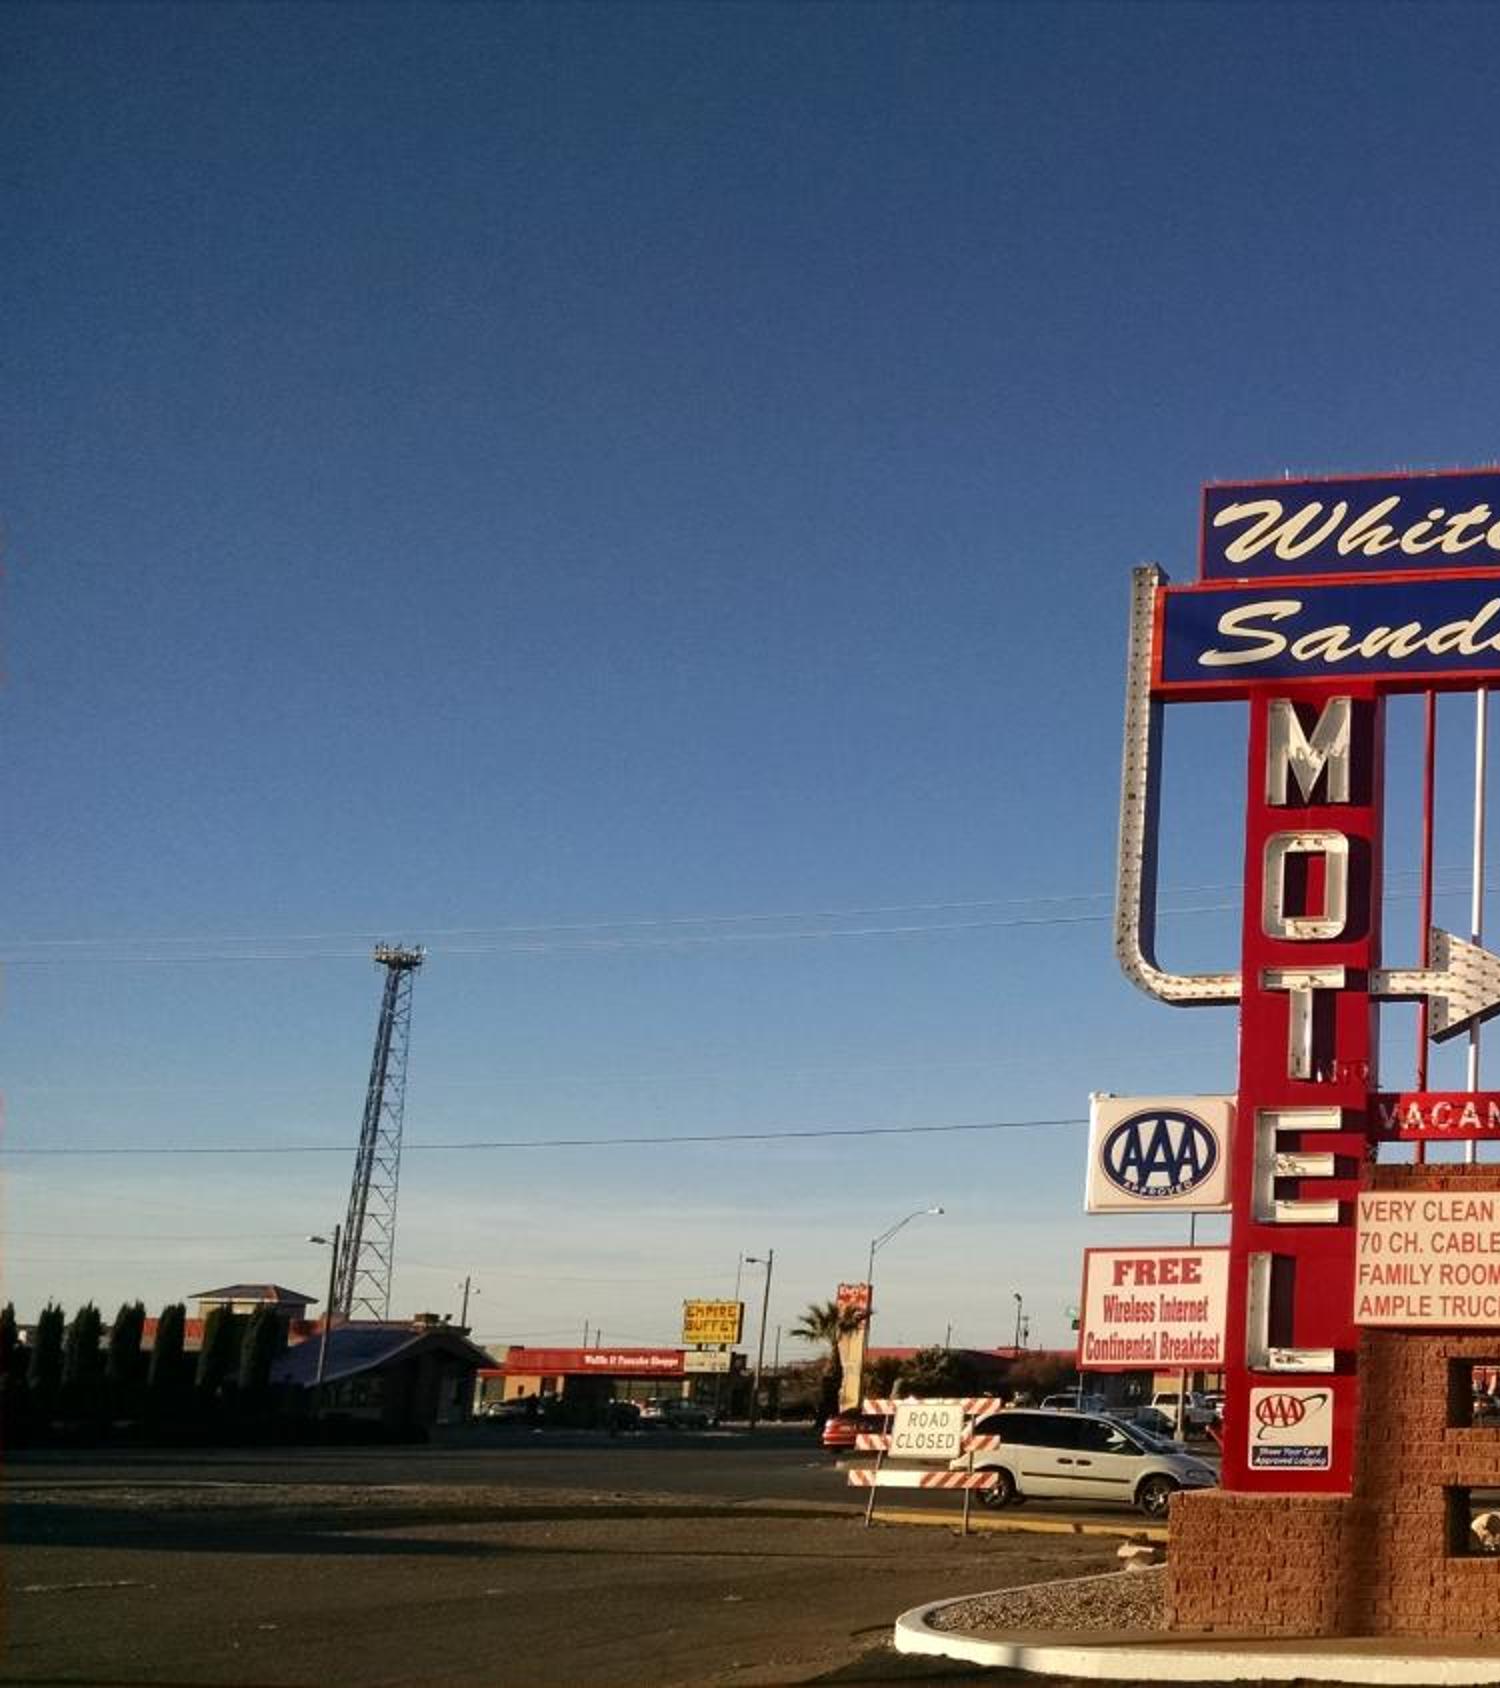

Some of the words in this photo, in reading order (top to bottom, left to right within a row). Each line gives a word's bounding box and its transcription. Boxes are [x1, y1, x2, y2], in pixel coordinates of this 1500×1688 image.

[1246, 695, 1351, 1372] MOTEL
[1118, 1113, 1202, 1188] AAA
[1361, 1200, 1416, 1221] VERY
[1423, 1200, 1494, 1222] CLEAN
[1359, 1232, 1382, 1253] 70
[1389, 1232, 1424, 1253] CH.
[1113, 1258, 1202, 1286] FREE
[1359, 1263, 1432, 1285] FAMILY
[1104, 1294, 1155, 1322] Wireless
[1160, 1294, 1208, 1322] Internet
[1359, 1295, 1432, 1317] AMPLE
[685, 1319, 737, 1332] BUFFET
[1086, 1332, 1157, 1360] Continental
[1160, 1331, 1220, 1360] Breakfast
[908, 1411, 950, 1428] ROAD
[1259, 1395, 1302, 1427] AAA
[895, 1433, 956, 1449] CLOSED
